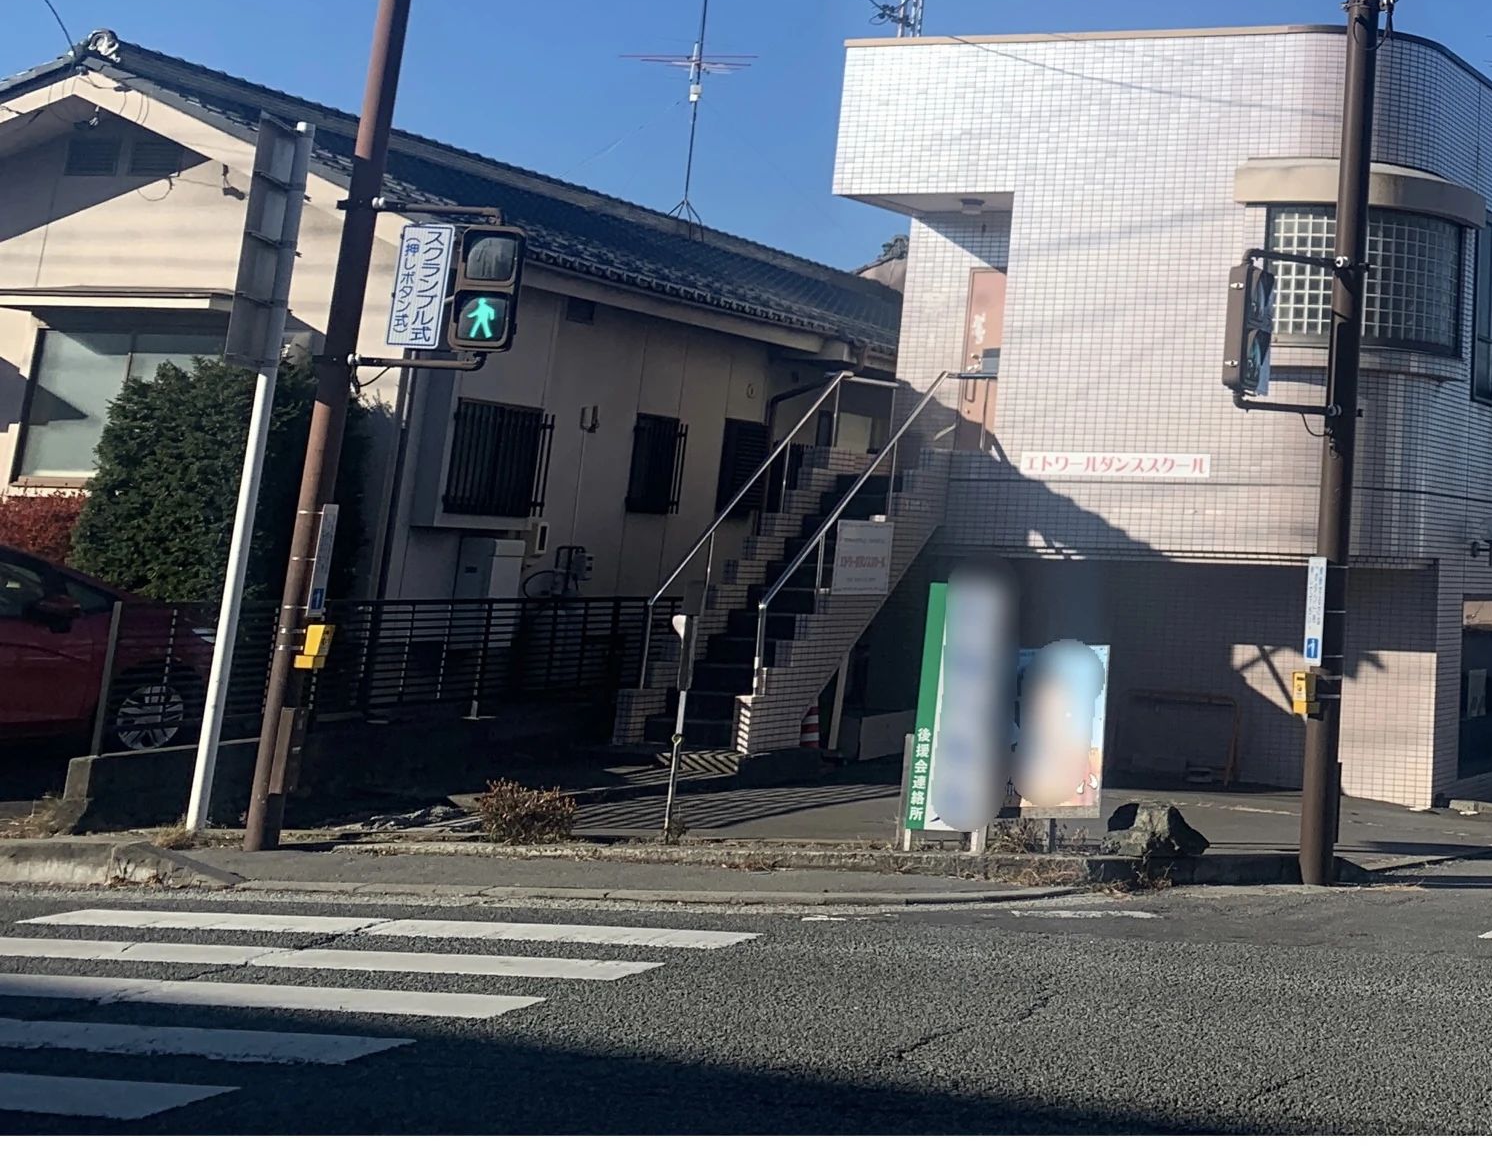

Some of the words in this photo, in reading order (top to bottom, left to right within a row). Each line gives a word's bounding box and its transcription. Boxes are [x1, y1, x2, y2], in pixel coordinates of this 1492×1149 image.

[409, 230, 444, 343] スクランブル式
[1026, 454, 1207, 475] エトワールダンススクール
[908, 727, 932, 822] 後援会連絡所
